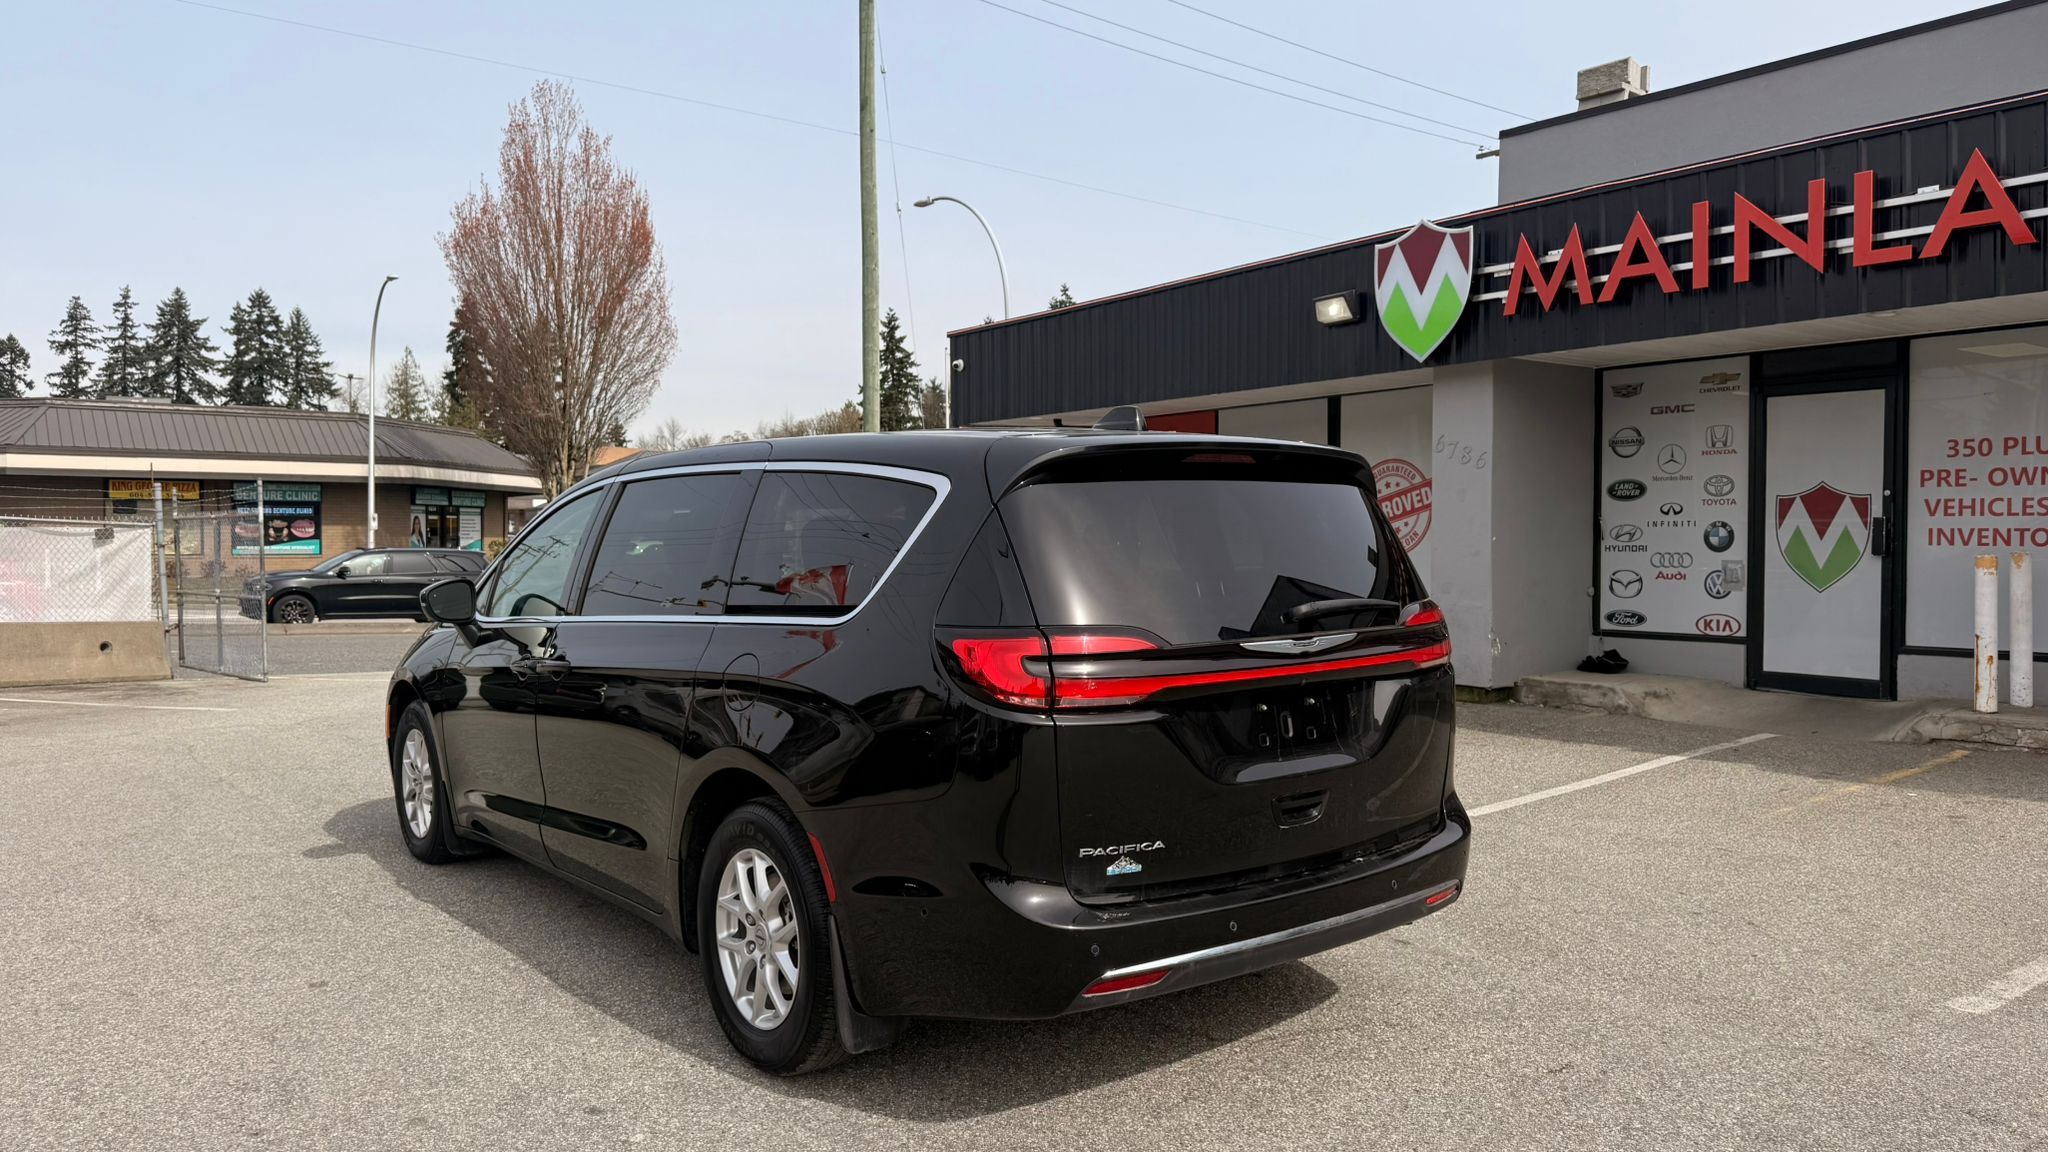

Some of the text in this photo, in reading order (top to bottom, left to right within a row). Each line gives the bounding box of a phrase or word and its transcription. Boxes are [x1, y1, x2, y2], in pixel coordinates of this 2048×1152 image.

[1503, 147, 2038, 317] MAINLA
[1699, 385, 1741, 394] CHEVROLET
[1650, 403, 1695, 415] GMC
[1433, 434, 1488, 470] 6786
[1701, 448, 1738, 456] HONDA
[1946, 435, 2048, 458] 350 PLU
[1374, 464, 1417, 481] GUARANTEED
[1920, 468, 1978, 488] PRE-
[112, 481, 132, 491] KING
[135, 481, 171, 492] GEOE
[235, 490, 318, 501] DENURE CLINIC
[1701, 498, 1737, 506] TOYOTA
[1923, 497, 2048, 517] VEHICLES
[1927, 527, 2048, 547] INVENTO
[1604, 544, 1648, 552] HYUNDAI
[1655, 571, 1687, 581] Audi
[1612, 612, 1639, 625] Ford
[1703, 619, 1734, 633] KIA
[1079, 840, 1166, 858] PACIFICA
